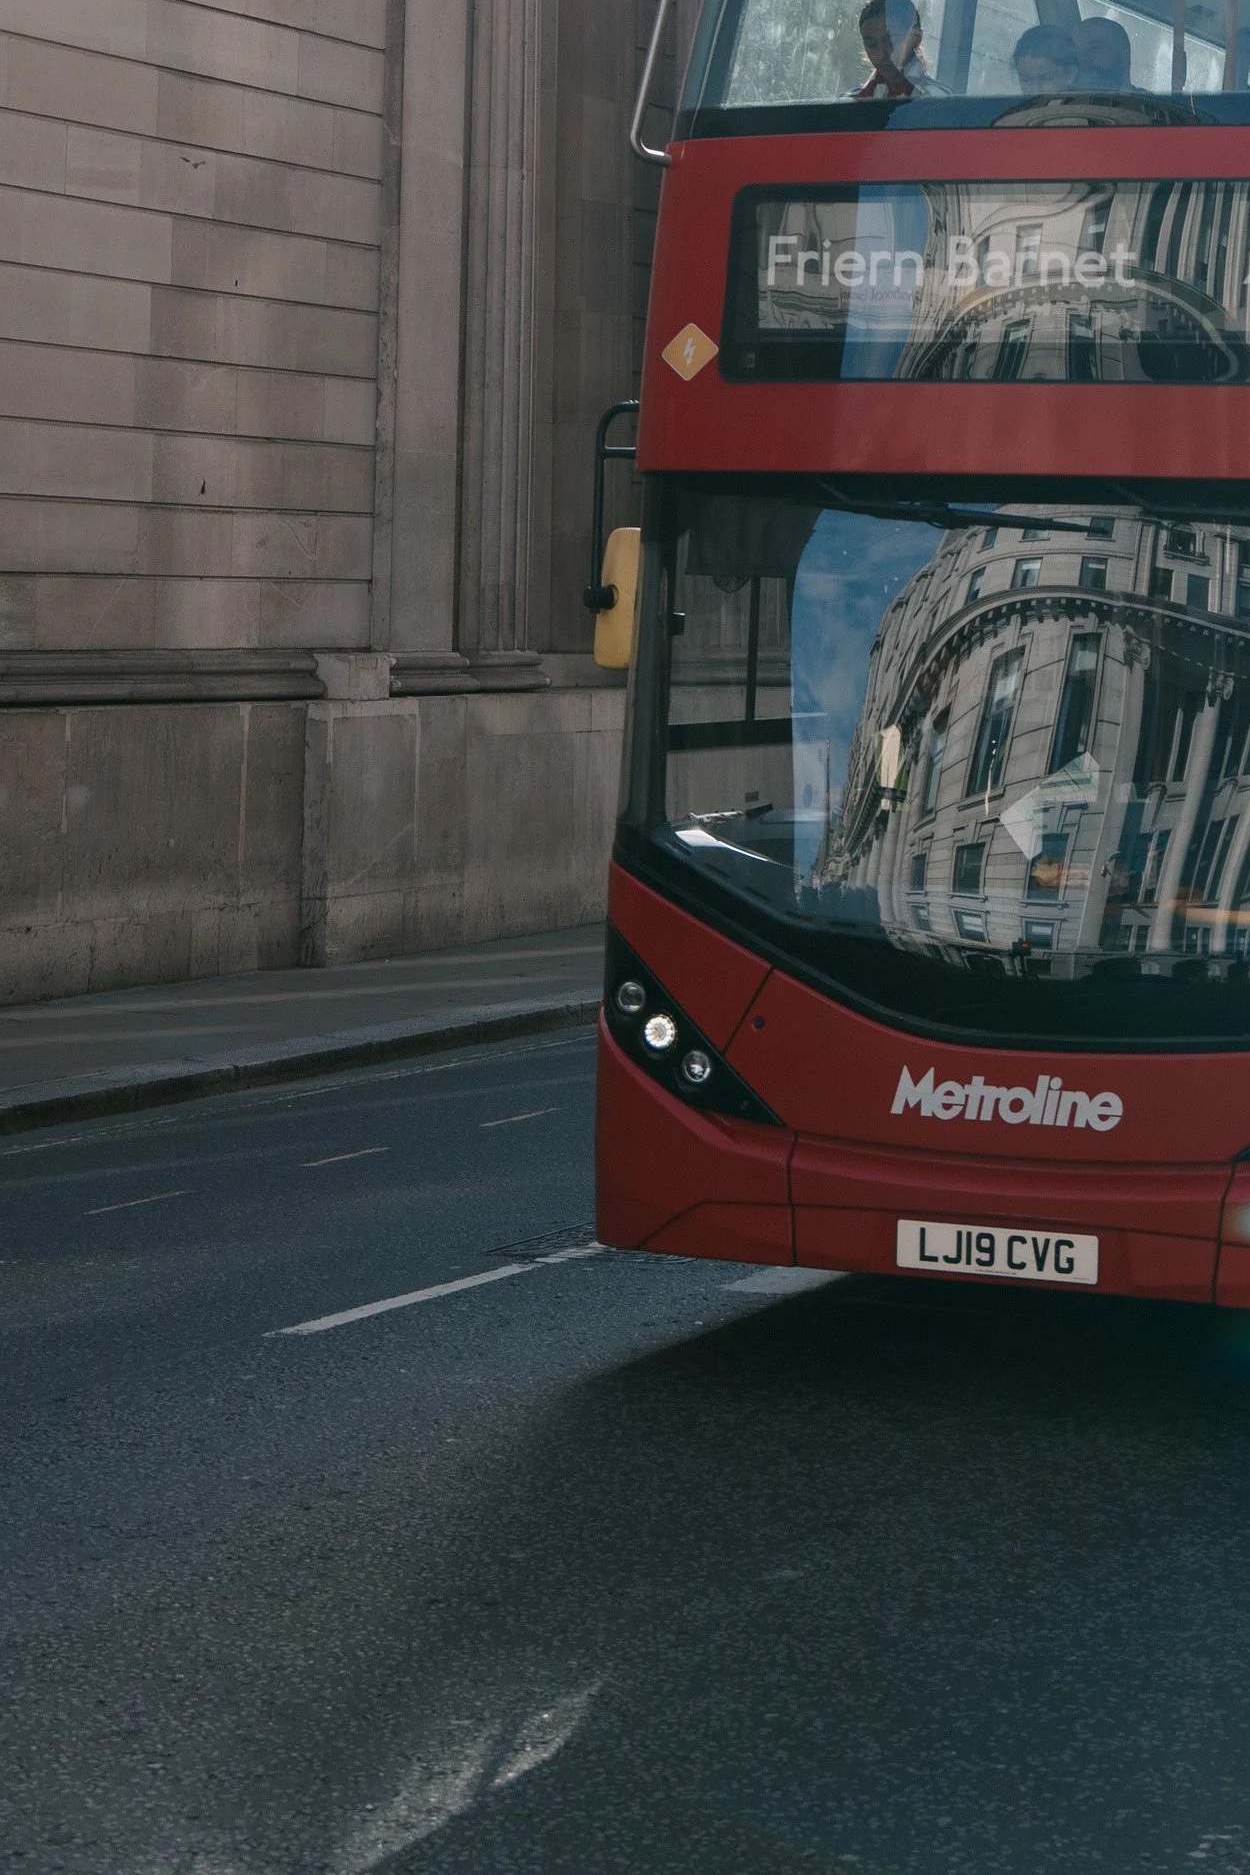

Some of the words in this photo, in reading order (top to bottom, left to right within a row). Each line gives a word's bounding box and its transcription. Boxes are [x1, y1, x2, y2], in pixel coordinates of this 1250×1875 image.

[766, 235, 924, 288] Friern
[946, 235, 1139, 288] Barnet
[889, 1065, 1124, 1132] Metroline
[918, 1227, 995, 1267] LJ19
[1006, 1235, 1075, 1275] CVG
